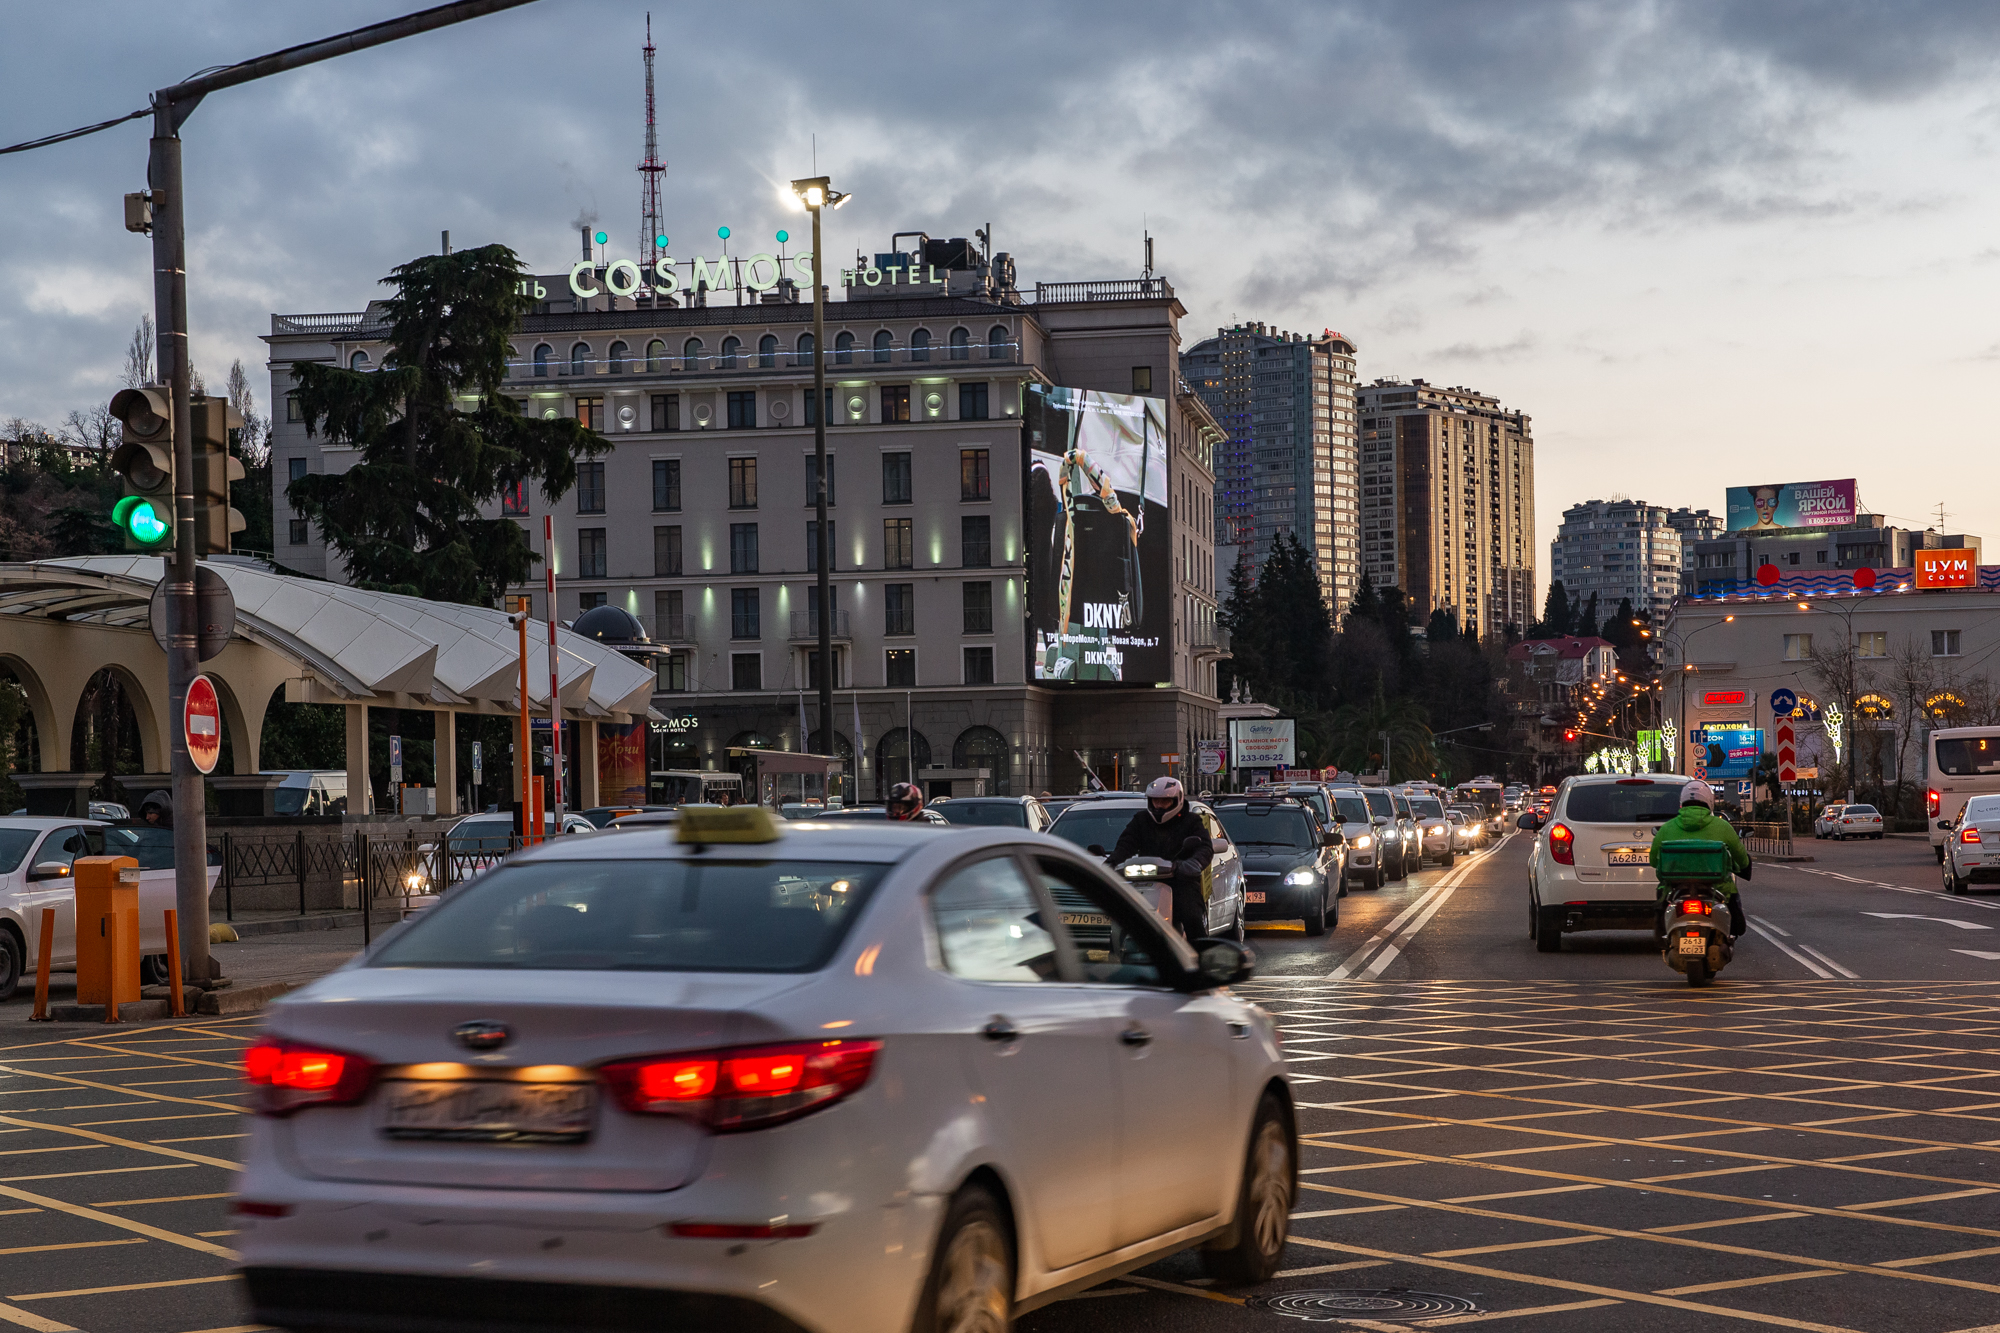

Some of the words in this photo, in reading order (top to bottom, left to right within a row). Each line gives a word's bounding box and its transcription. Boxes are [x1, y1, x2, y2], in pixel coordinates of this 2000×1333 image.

[569, 252, 814, 298] COSMOS
[840, 264, 943, 288] HOTEL
[1794, 485, 1835, 500] ВАШЕЙ
[1798, 494, 1846, 512] ЯРКОЙ
[1924, 560, 1968, 573] ЦУМ
[1083, 602, 1123, 629] DKNY
[1046, 632, 1059, 644] ТРЦ
[1101, 636, 1111, 646] ул.
[1112, 635, 1130, 645] Новая
[1130, 636, 1147, 648] Заря,
[1147, 638, 1154, 647] д.
[1154, 637, 1159, 646] 7
[1084, 650, 1124, 666] DKNY.RU
[1249, 724, 1274, 735] Gallery
[1695, 746, 1704, 755] 60
[1980, 740, 1986, 750] 3
[1241, 753, 1284, 762] 233-05-22
[1285, 770, 1308, 778] ПРЕССА
[1612, 853, 1649, 863] А628АТ
[1063, 914, 1103, 924] Р770РВ
